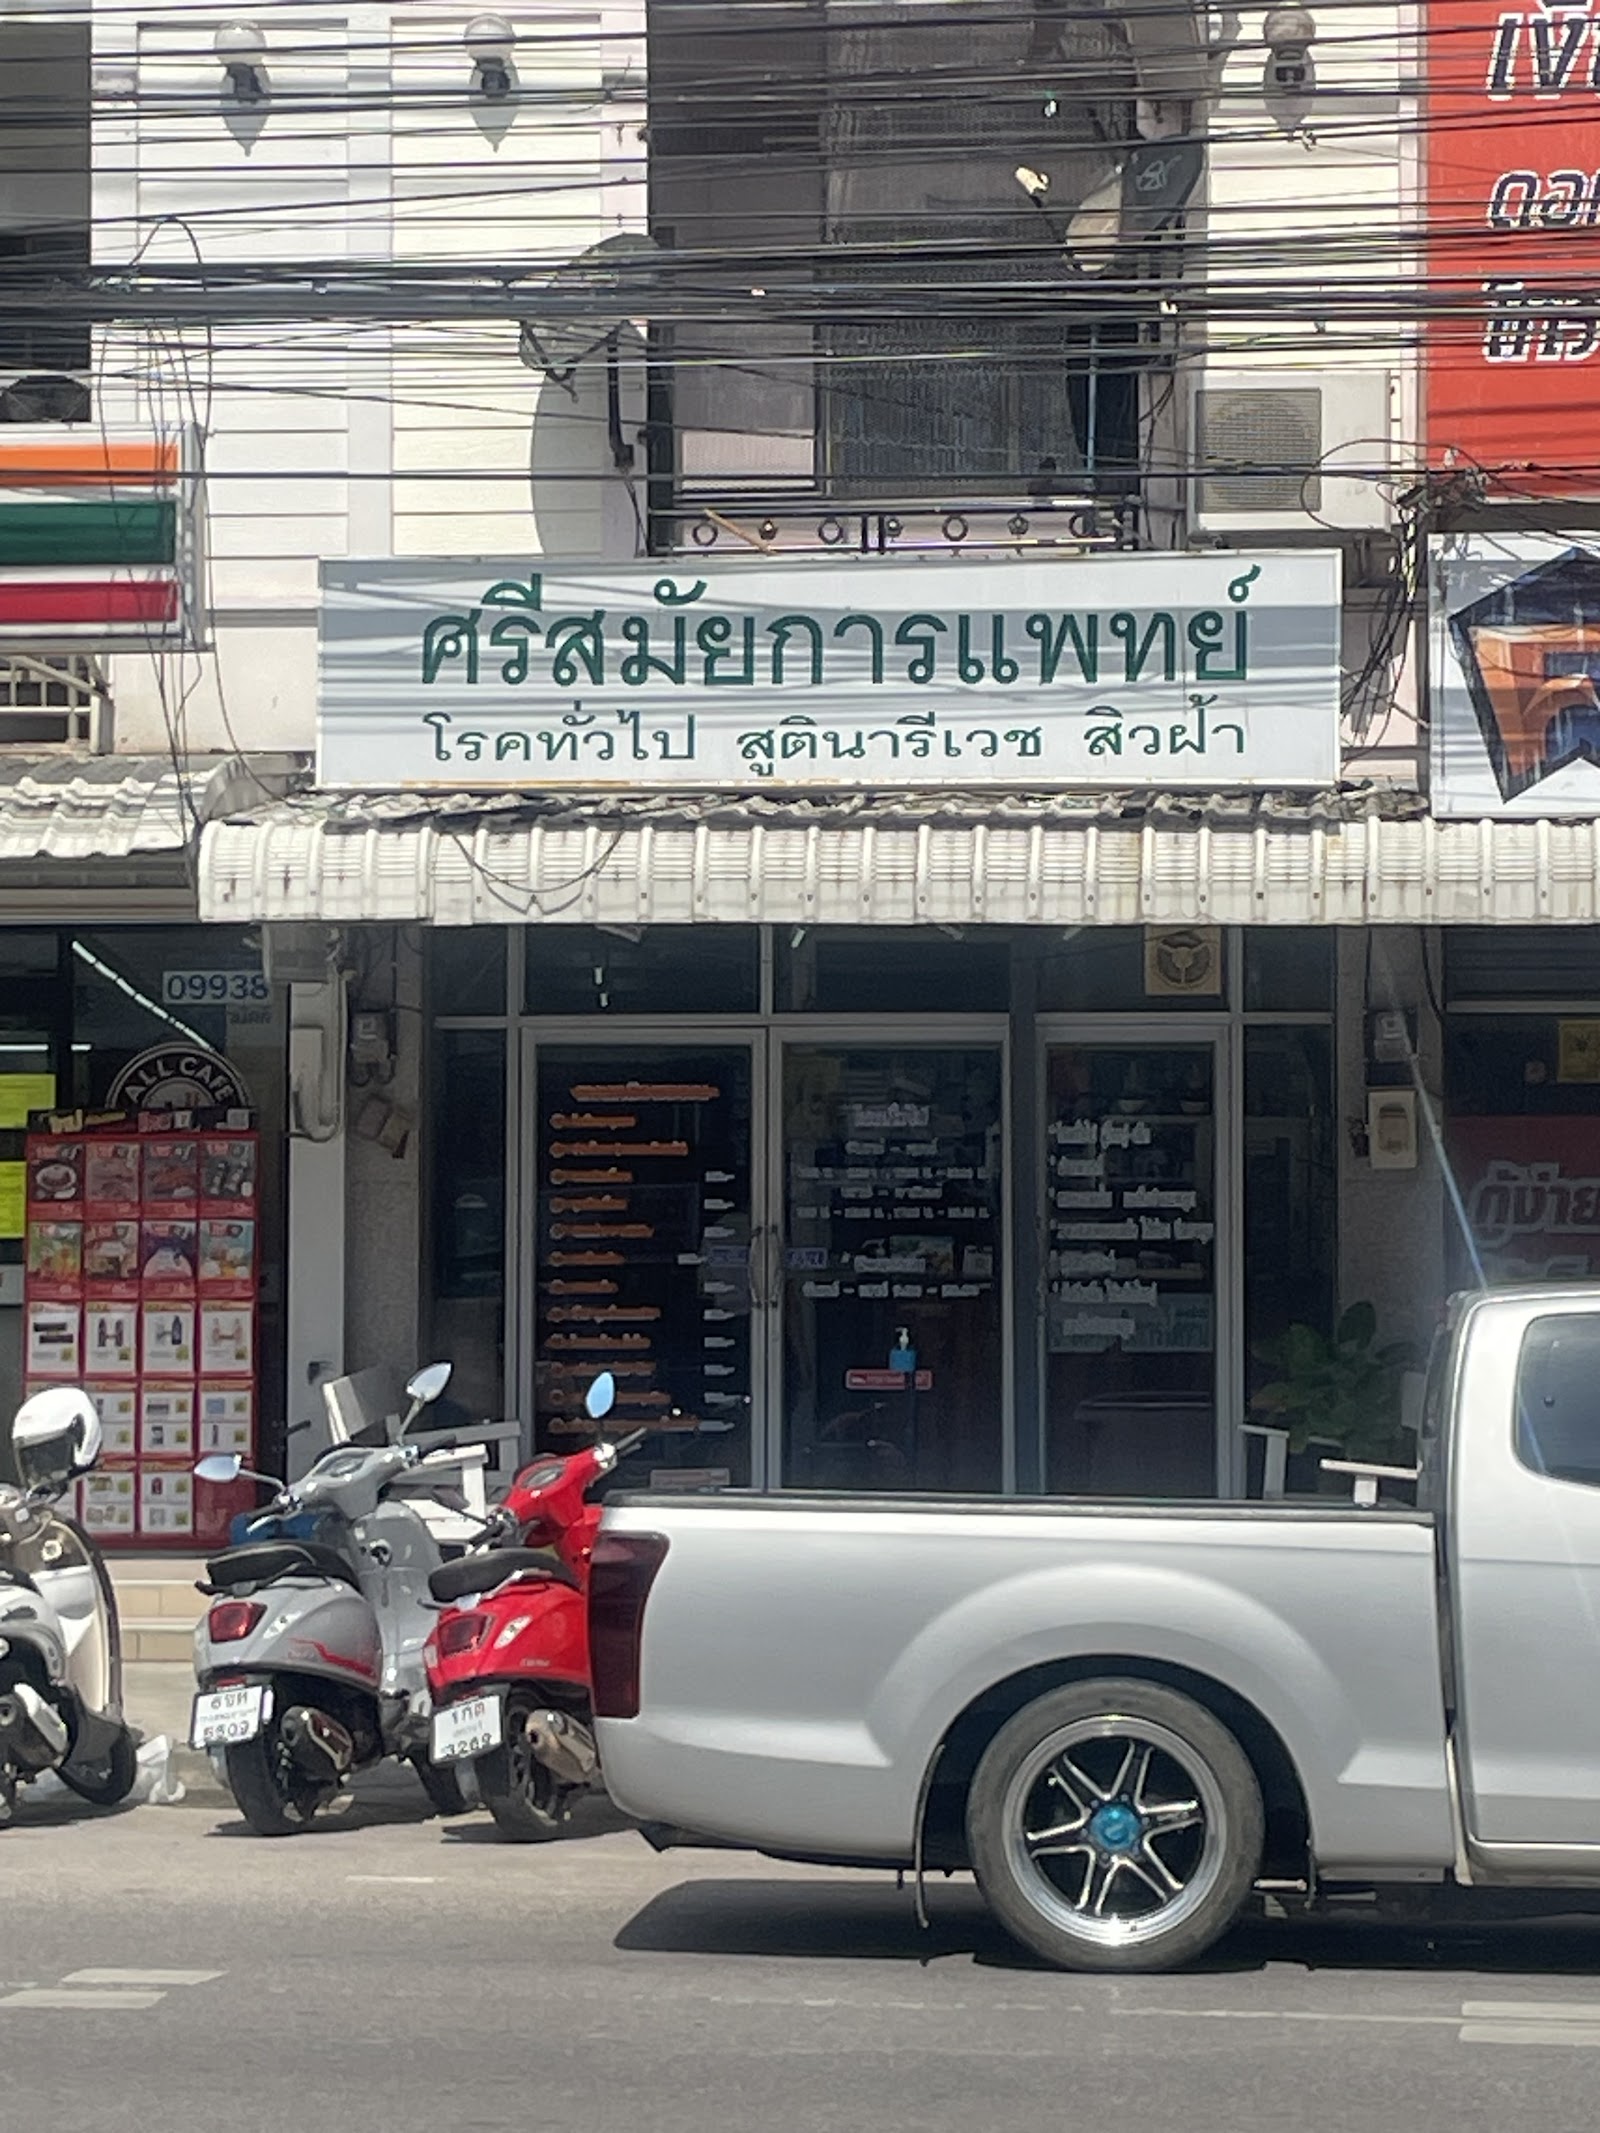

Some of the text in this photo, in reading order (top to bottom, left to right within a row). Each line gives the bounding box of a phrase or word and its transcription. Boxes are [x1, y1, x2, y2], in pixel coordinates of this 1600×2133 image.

[421, 564, 1261, 687] ศรีสมัยการแพทย์
[422, 693, 1245, 777] โรคทั่วไป สูตินารีเวช สิวฝ้า
[167, 974, 269, 1000] 09938
[125, 1059, 174, 1103] ALL
